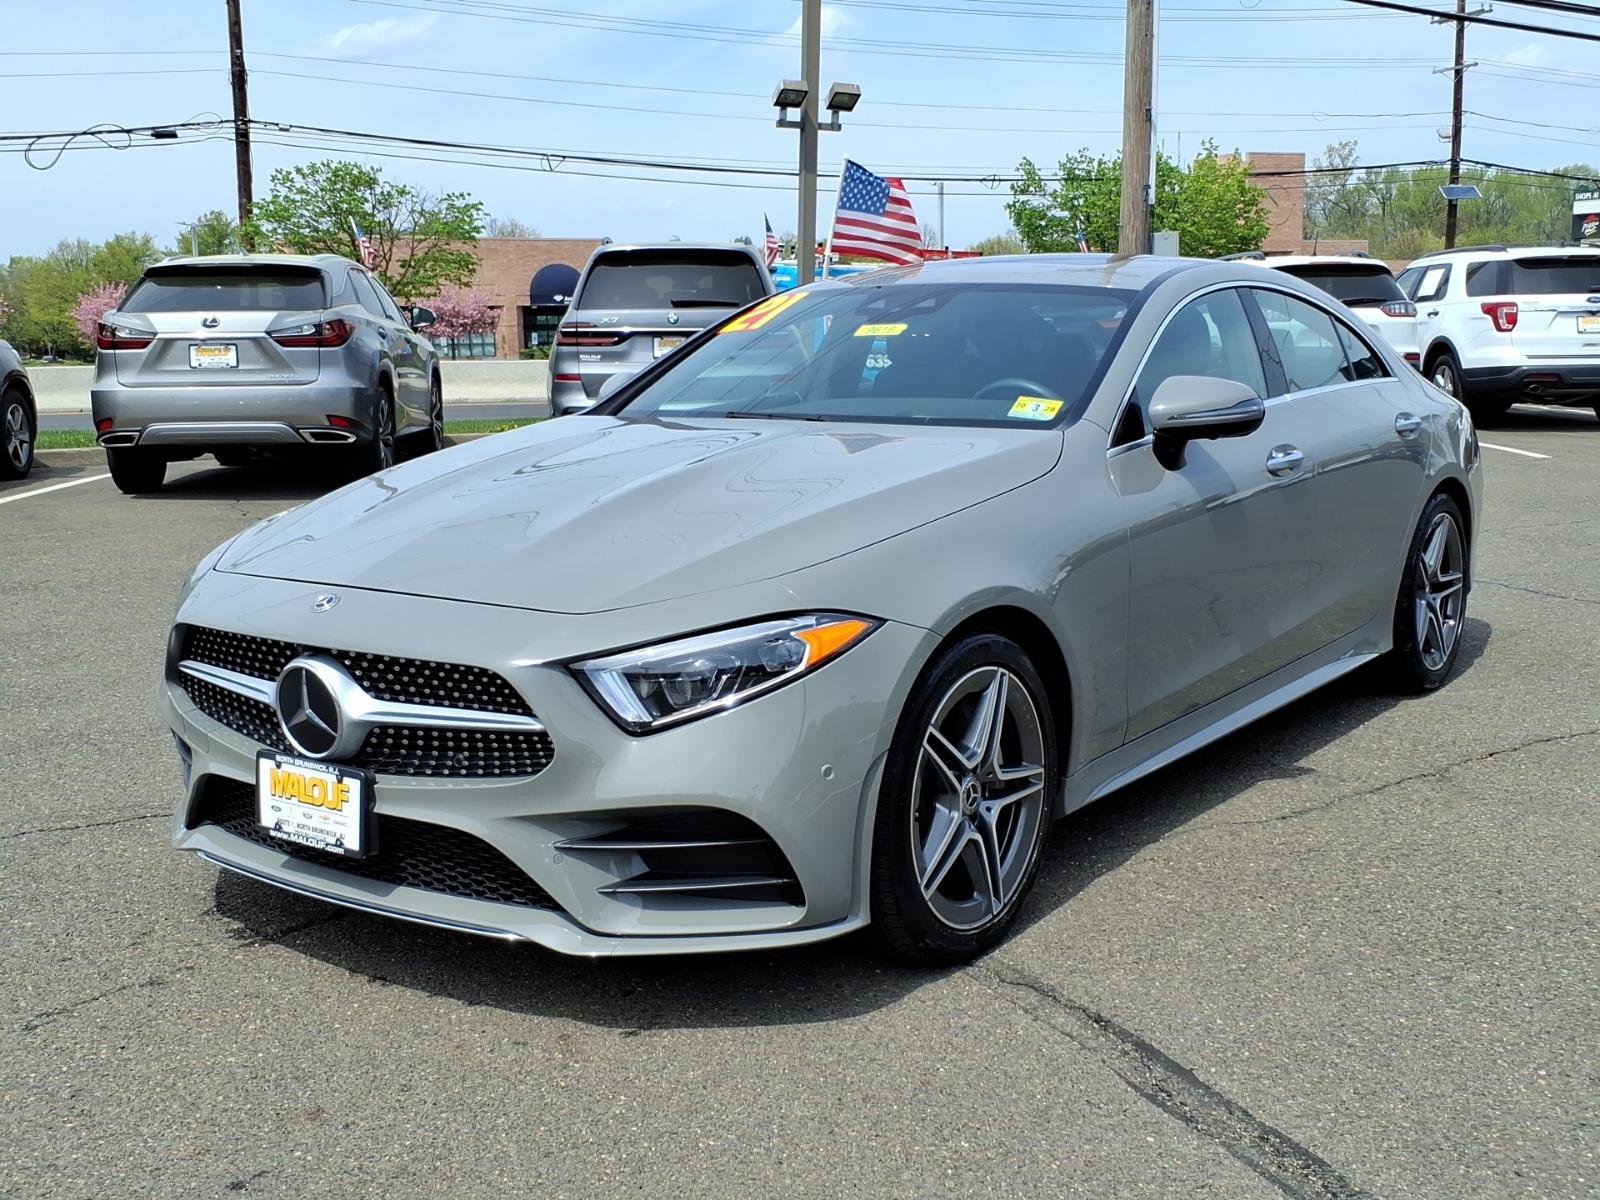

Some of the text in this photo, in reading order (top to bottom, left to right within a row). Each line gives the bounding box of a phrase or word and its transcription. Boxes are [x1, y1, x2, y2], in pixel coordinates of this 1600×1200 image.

[1031, 403, 1040, 411] 3
[275, 754, 294, 765] NORTH
[270, 768, 350, 811] MALOUF
